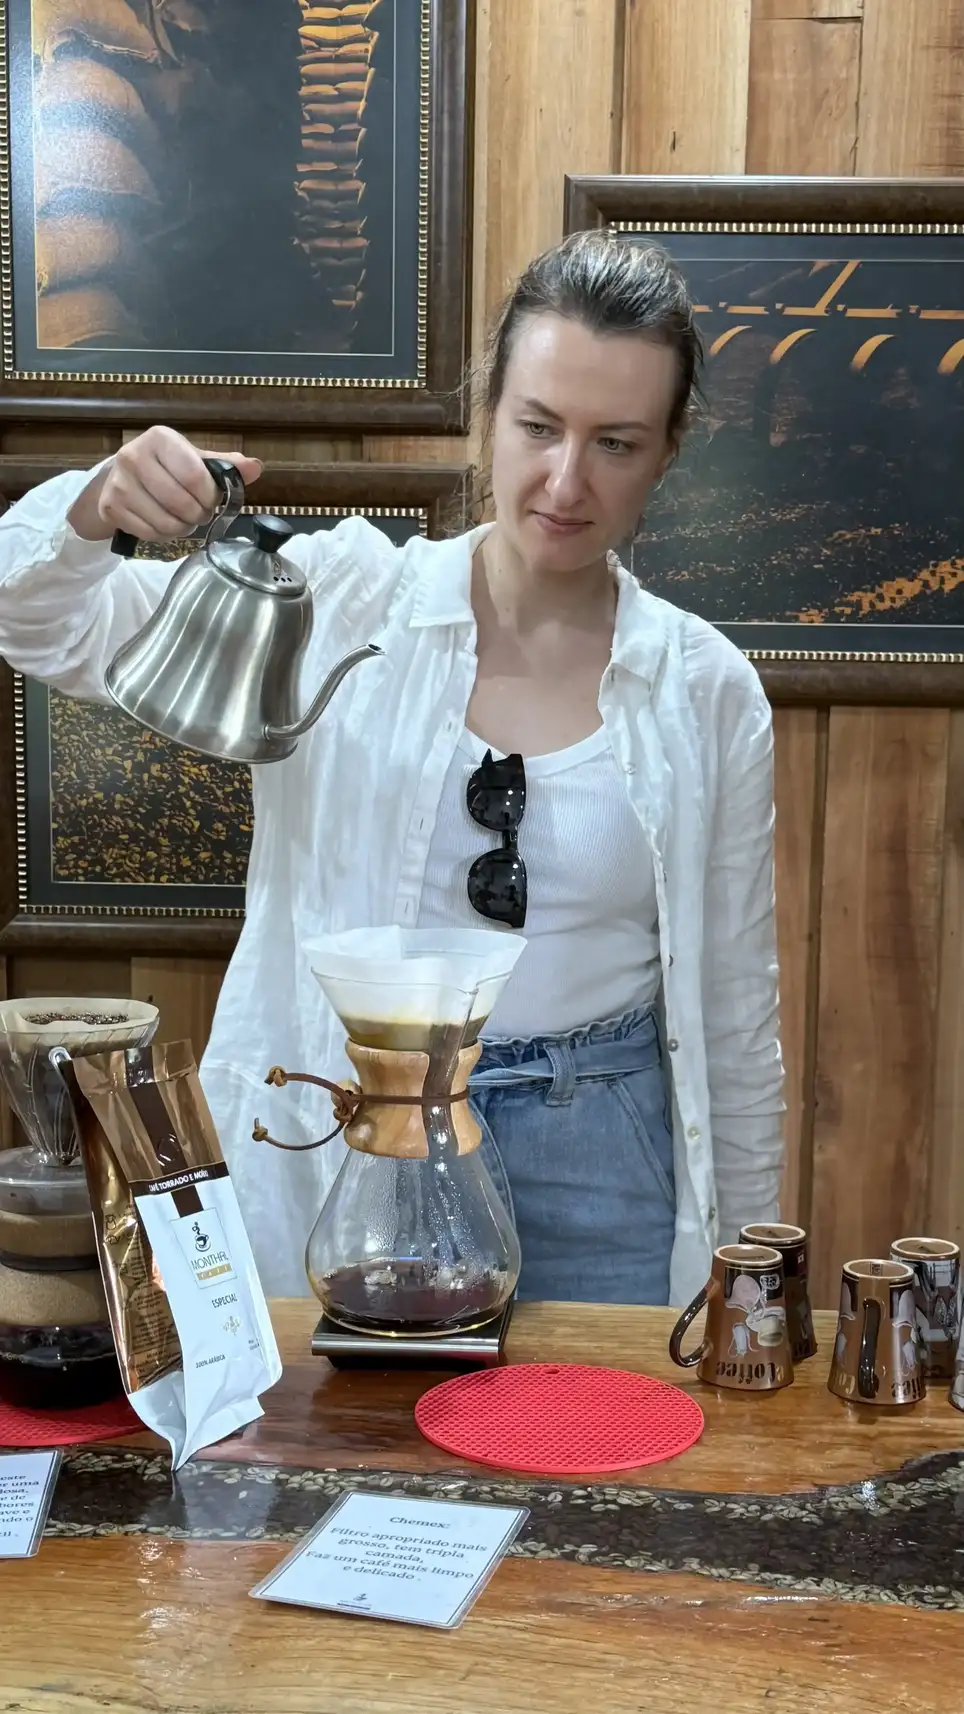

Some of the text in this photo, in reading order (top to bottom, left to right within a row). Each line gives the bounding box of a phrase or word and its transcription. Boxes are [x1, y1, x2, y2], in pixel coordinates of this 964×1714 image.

[159, 1174, 189, 1190] TORRADO
[330, 1526, 487, 1552] Filtro apropriado mais
[337, 1537, 465, 1559] grosso, tem tripla
[305, 1550, 475, 1579] Faz um café mais limpo
[365, 1549, 424, 1564] camada,
